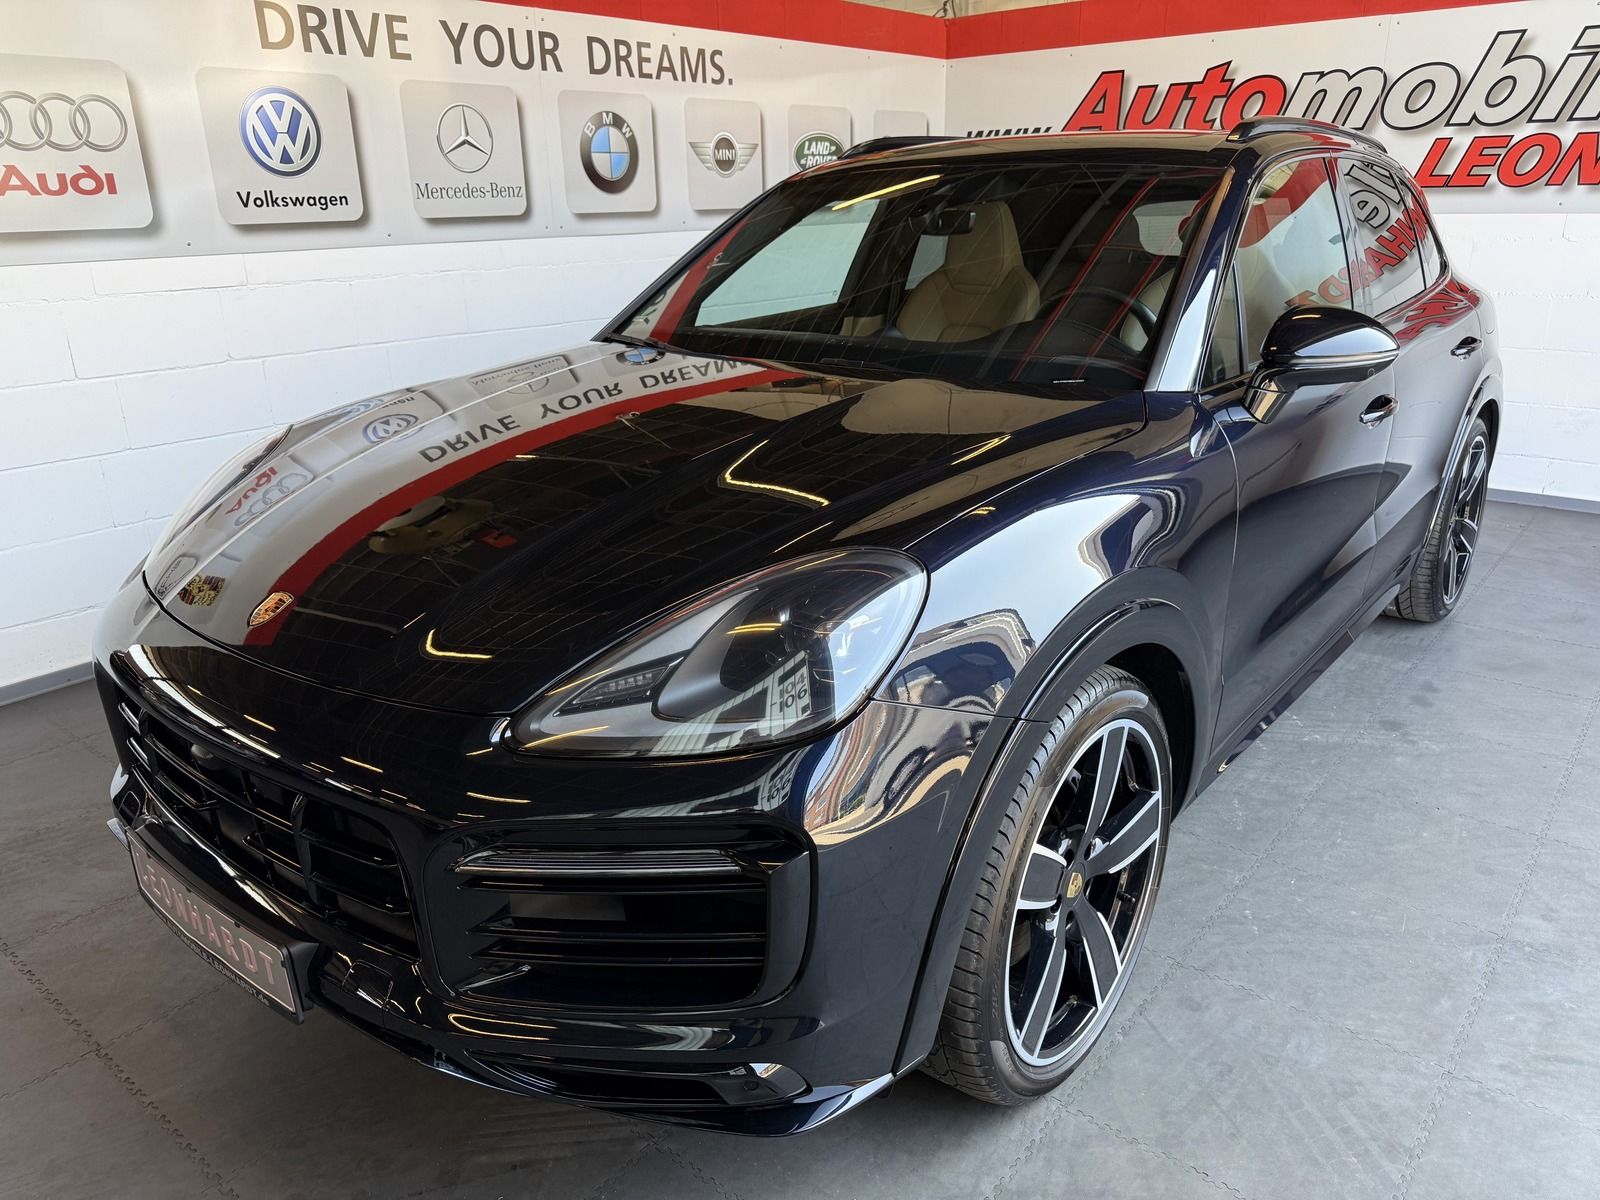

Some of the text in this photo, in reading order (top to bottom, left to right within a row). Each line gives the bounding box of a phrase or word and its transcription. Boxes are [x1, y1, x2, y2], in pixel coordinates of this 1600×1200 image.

[254, 0, 733, 86] DRIVE YOUR DREAMS.
[584, 112, 633, 139] BMW
[714, 149, 736, 161] MINI
[804, 141, 831, 155] LAND
[0, 164, 118, 196] Audi
[415, 182, 524, 200] Mercedes-Benz
[235, 190, 349, 210] Volkswagen
[136, 851, 275, 986] LEONHARDT
